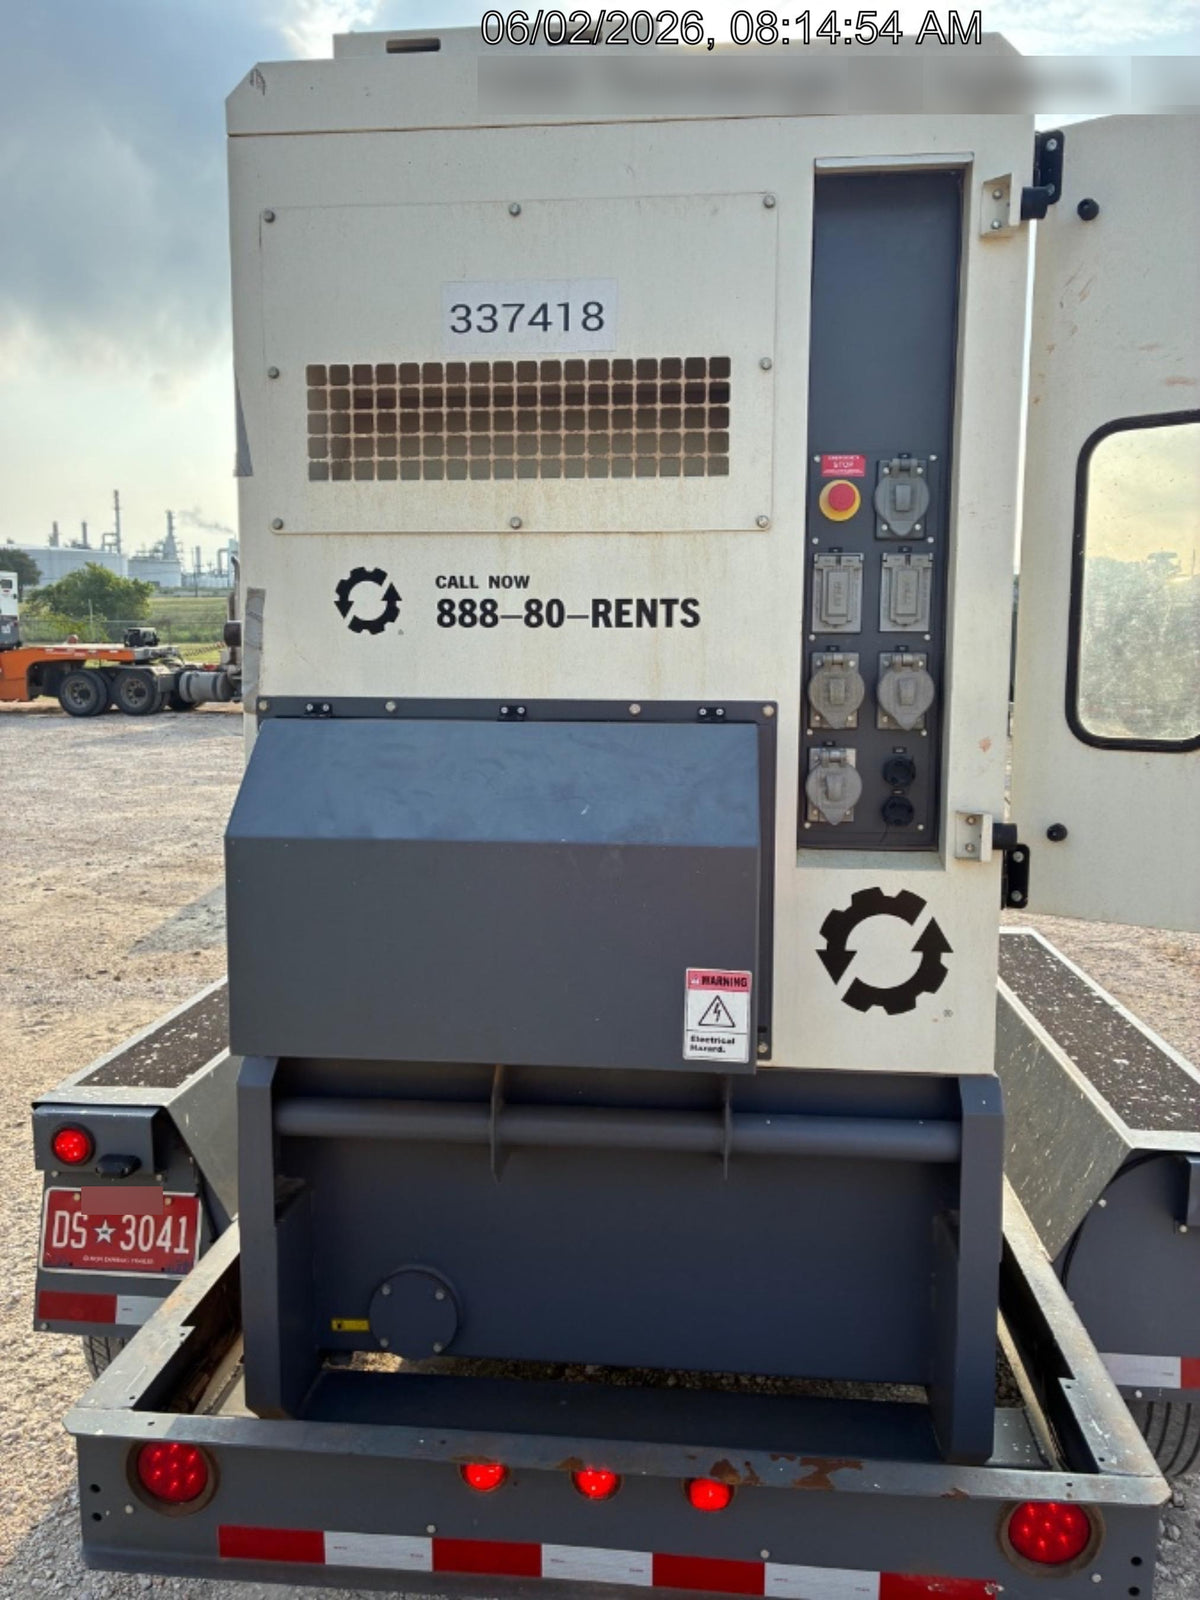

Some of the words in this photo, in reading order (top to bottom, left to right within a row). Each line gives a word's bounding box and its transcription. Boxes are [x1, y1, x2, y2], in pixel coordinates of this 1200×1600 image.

[450, 301, 604, 334] 337418
[435, 575, 479, 589] CALL
[488, 575, 531, 589] NOW
[701, 975, 748, 988] WARNING
[690, 1034, 736, 1045] Electrical
[52, 1210, 88, 1249] DS
[120, 1214, 190, 1254] 3041
